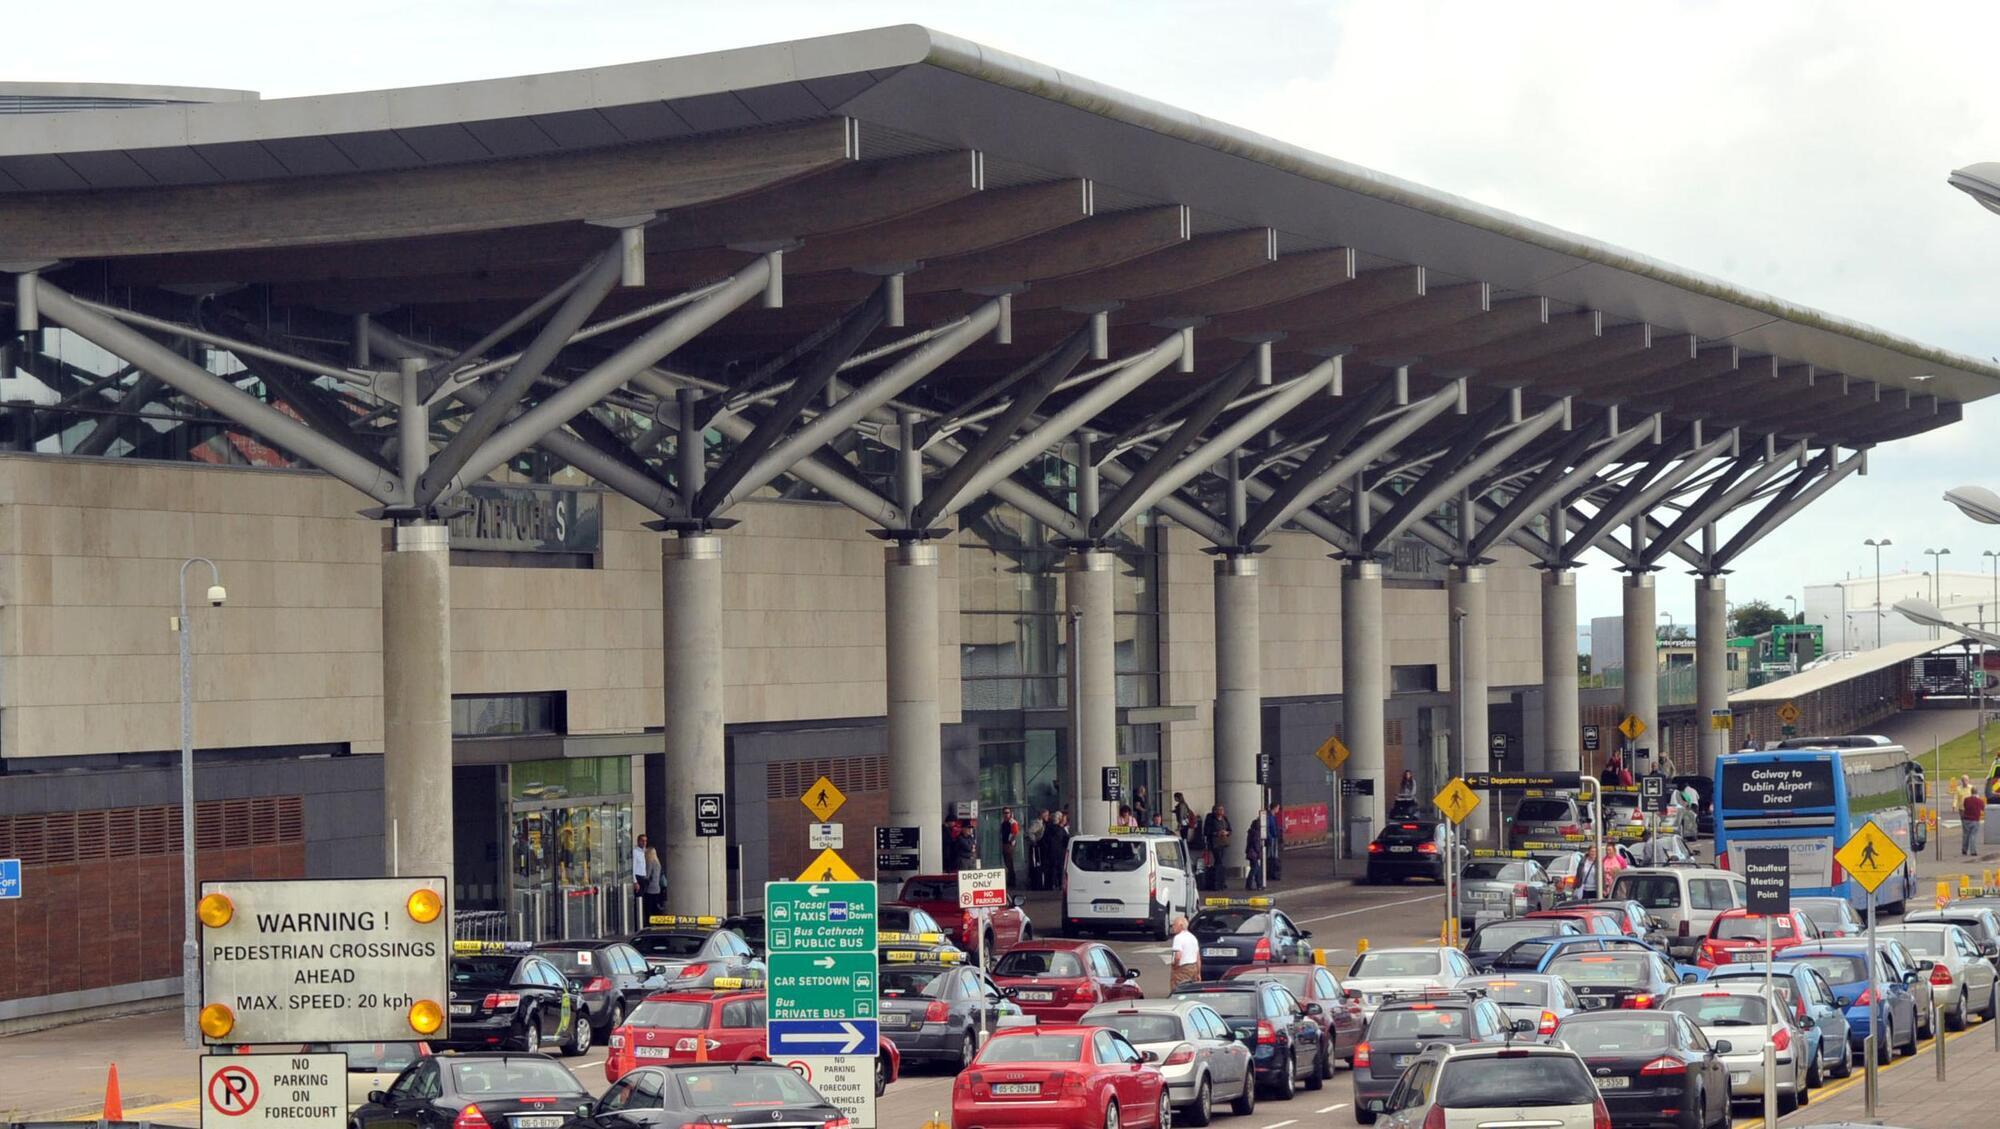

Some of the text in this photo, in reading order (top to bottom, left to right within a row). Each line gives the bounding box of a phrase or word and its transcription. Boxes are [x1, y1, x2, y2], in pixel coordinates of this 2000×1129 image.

[1751, 769, 1802, 780] Galway to
[1490, 777, 1527, 785] Departures
[1743, 781, 1812, 792] Dublin Airport
[1763, 794, 1792, 803] Direct
[1747, 864, 1787, 872] Chauffeur
[962, 872, 1002, 880] DROP-OFF
[973, 880, 992, 888] ONLY
[1751, 878, 1784, 887] Meeting
[1757, 891, 1778, 899] Point
[975, 897, 1002, 905] PARKING
[829, 907, 848, 915] PRM
[849, 902, 865, 911] Set
[794, 911, 874, 921] TAXIS Down
[257, 911, 375, 933] WARNING
[794, 926, 864, 936] Bus Cathrach
[900, 933, 918, 942] TAXI
[482, 941, 504, 949] TAXI
[795, 938, 863, 948] PUBLIC BUS
[213, 942, 436, 961] PEDESTRIAN CROSSINGS
[919, 952, 937, 960] TAXI
[294, 968, 355, 984] AHEAD
[774, 976, 850, 986] CAR SETDOWN
[236, 993, 413, 1011] MAX. SPEED: 20 kph
[775, 997, 796, 1007] Bus
[775, 1008, 846, 1018] PRIVATE BUS
[291, 1058, 310, 1070] NO
[274, 1074, 328, 1086] PARKING
[834, 1074, 845, 1082] ON
[819, 1083, 861, 1091] FORECOURT
[292, 1090, 310, 1102] ON
[831, 1096, 865, 1104] VEHICLES
[265, 1106, 338, 1118] FORECOURT
